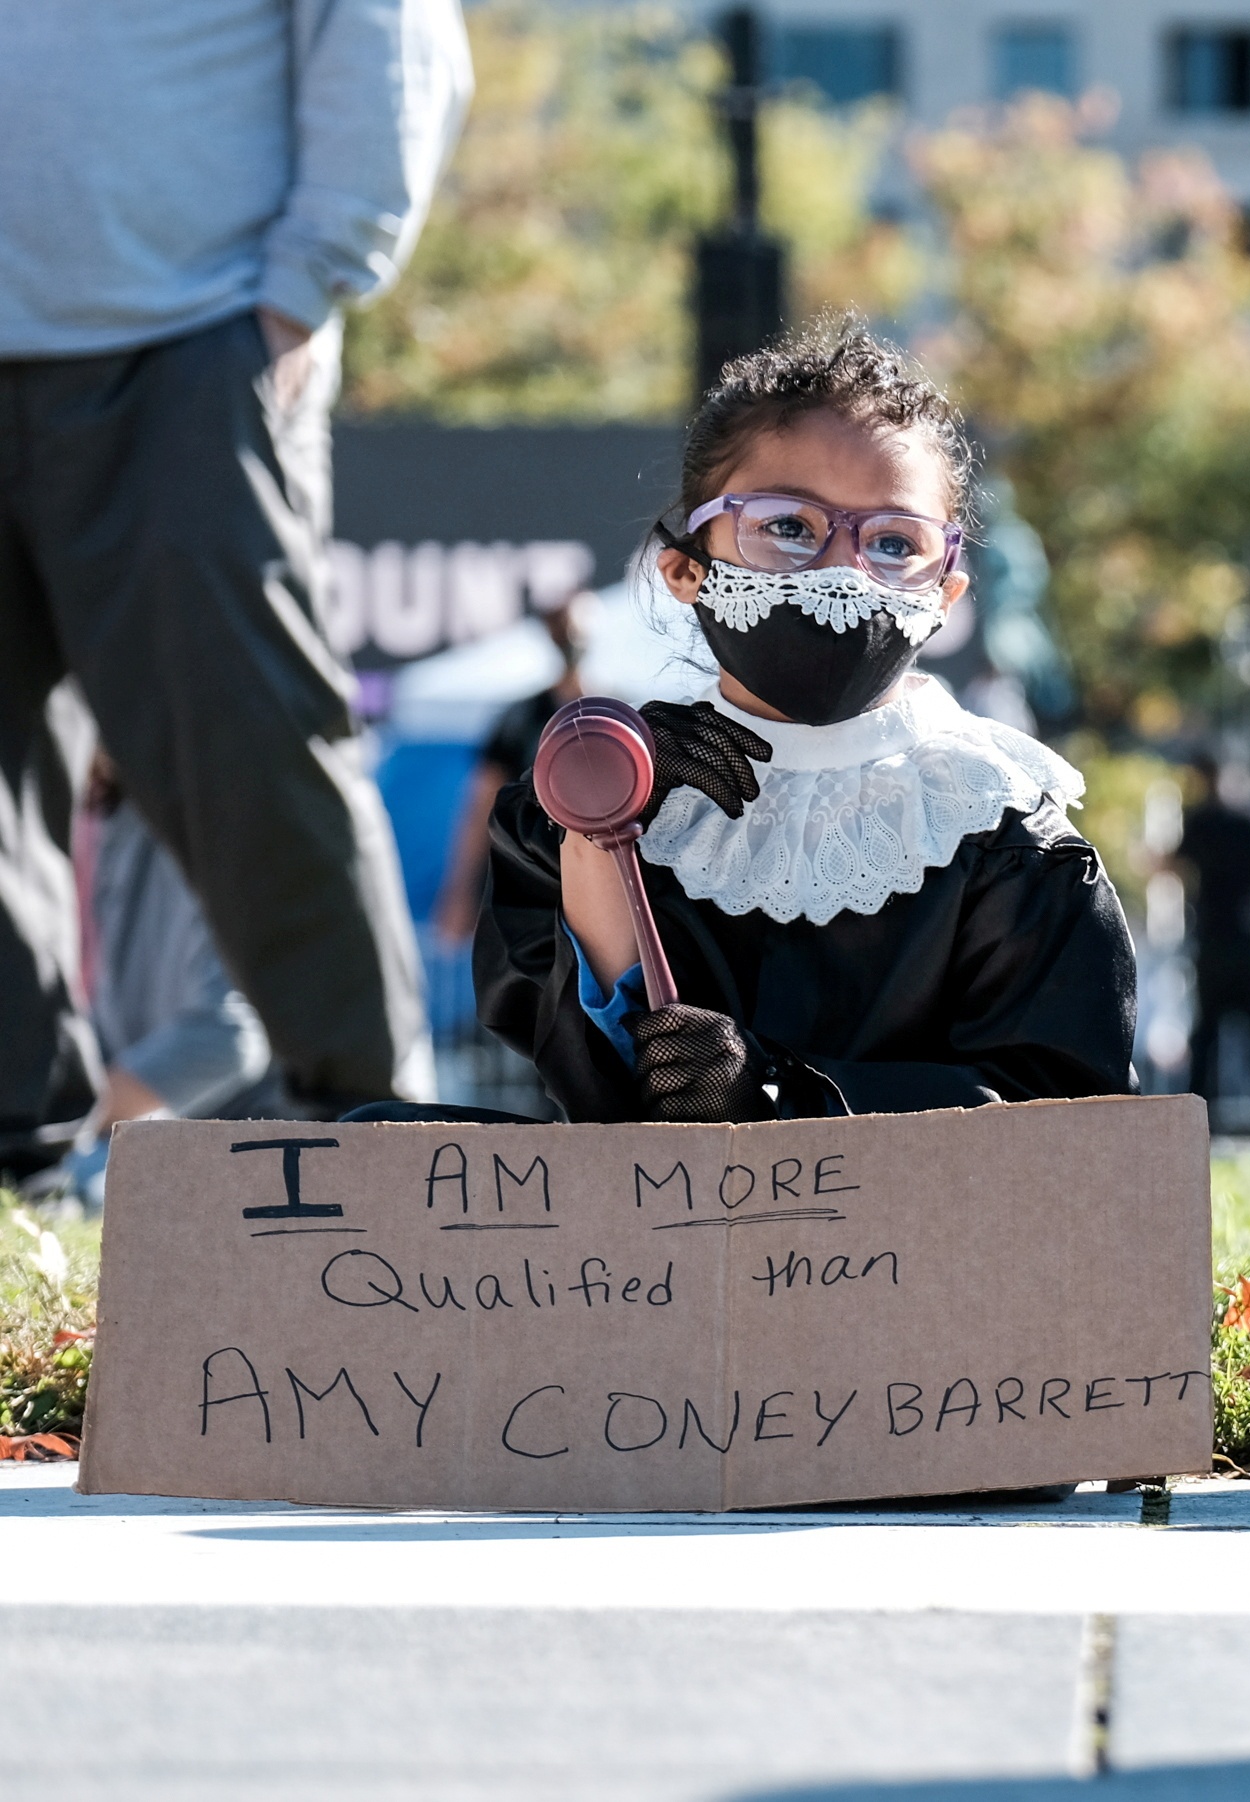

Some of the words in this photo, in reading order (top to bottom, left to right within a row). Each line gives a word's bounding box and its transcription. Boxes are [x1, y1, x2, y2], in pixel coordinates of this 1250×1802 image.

[230, 1137, 342, 1219] I
[425, 1143, 552, 1212] AM
[635, 1154, 861, 1212] MORE
[321, 1249, 674, 1313] Qualified
[752, 1248, 900, 1294] than
[199, 1346, 441, 1448] AMY
[502, 1384, 857, 1460] CONEY
[887, 1370, 1211, 1436] BARRETT
